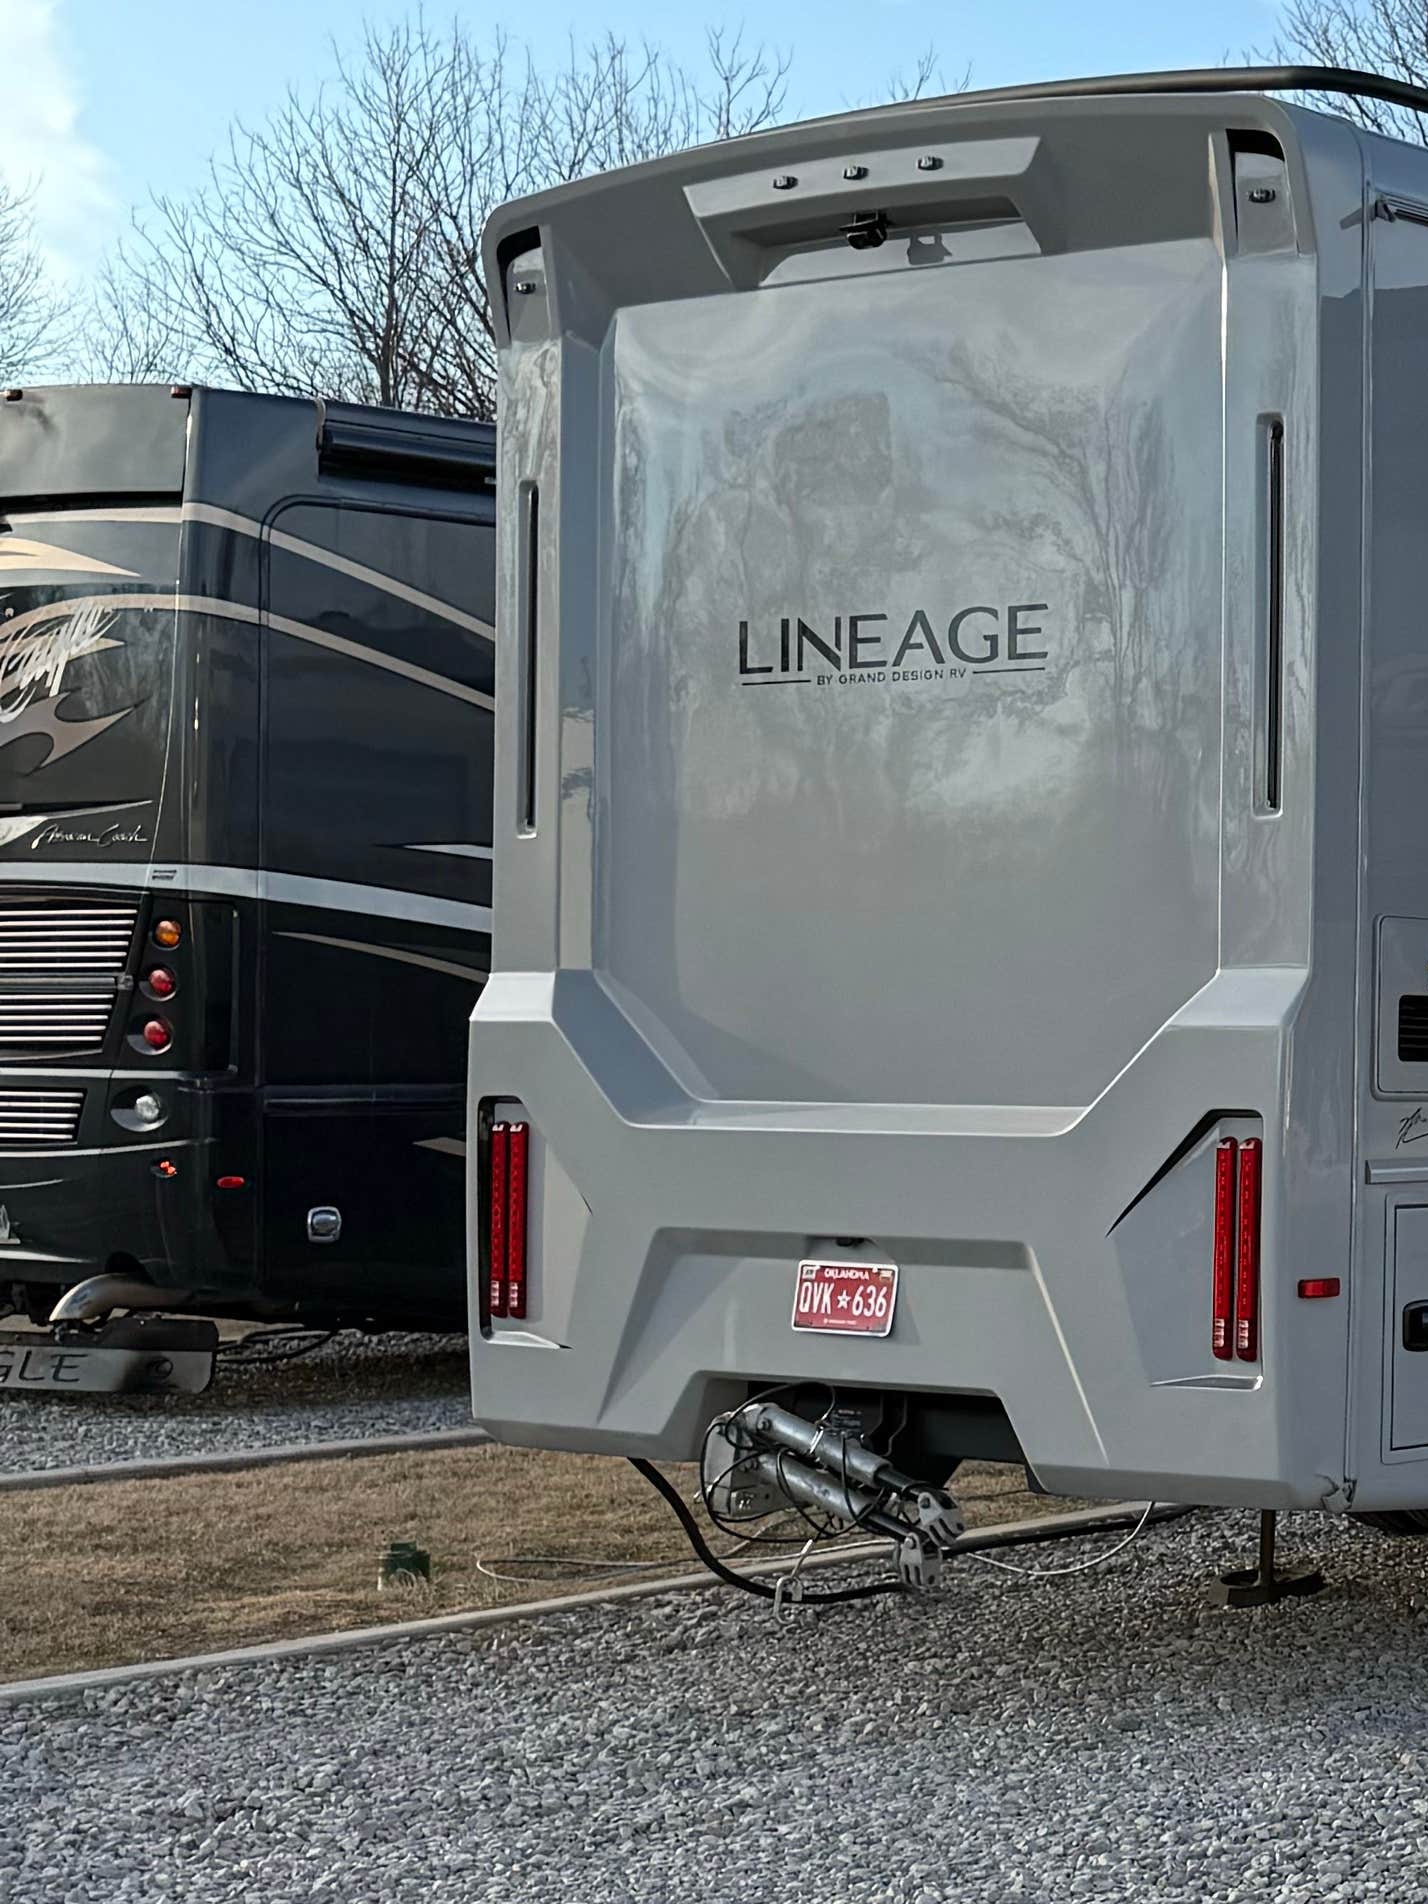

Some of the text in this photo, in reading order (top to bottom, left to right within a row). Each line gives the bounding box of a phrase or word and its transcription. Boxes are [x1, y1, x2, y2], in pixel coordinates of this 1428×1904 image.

[739, 603, 1048, 674] LINEAGE
[817, 668, 966, 685] BY GRAND DESIGN RV
[824, 1268, 869, 1280] OKLAHOMA
[852, 1285, 887, 1317] 636
